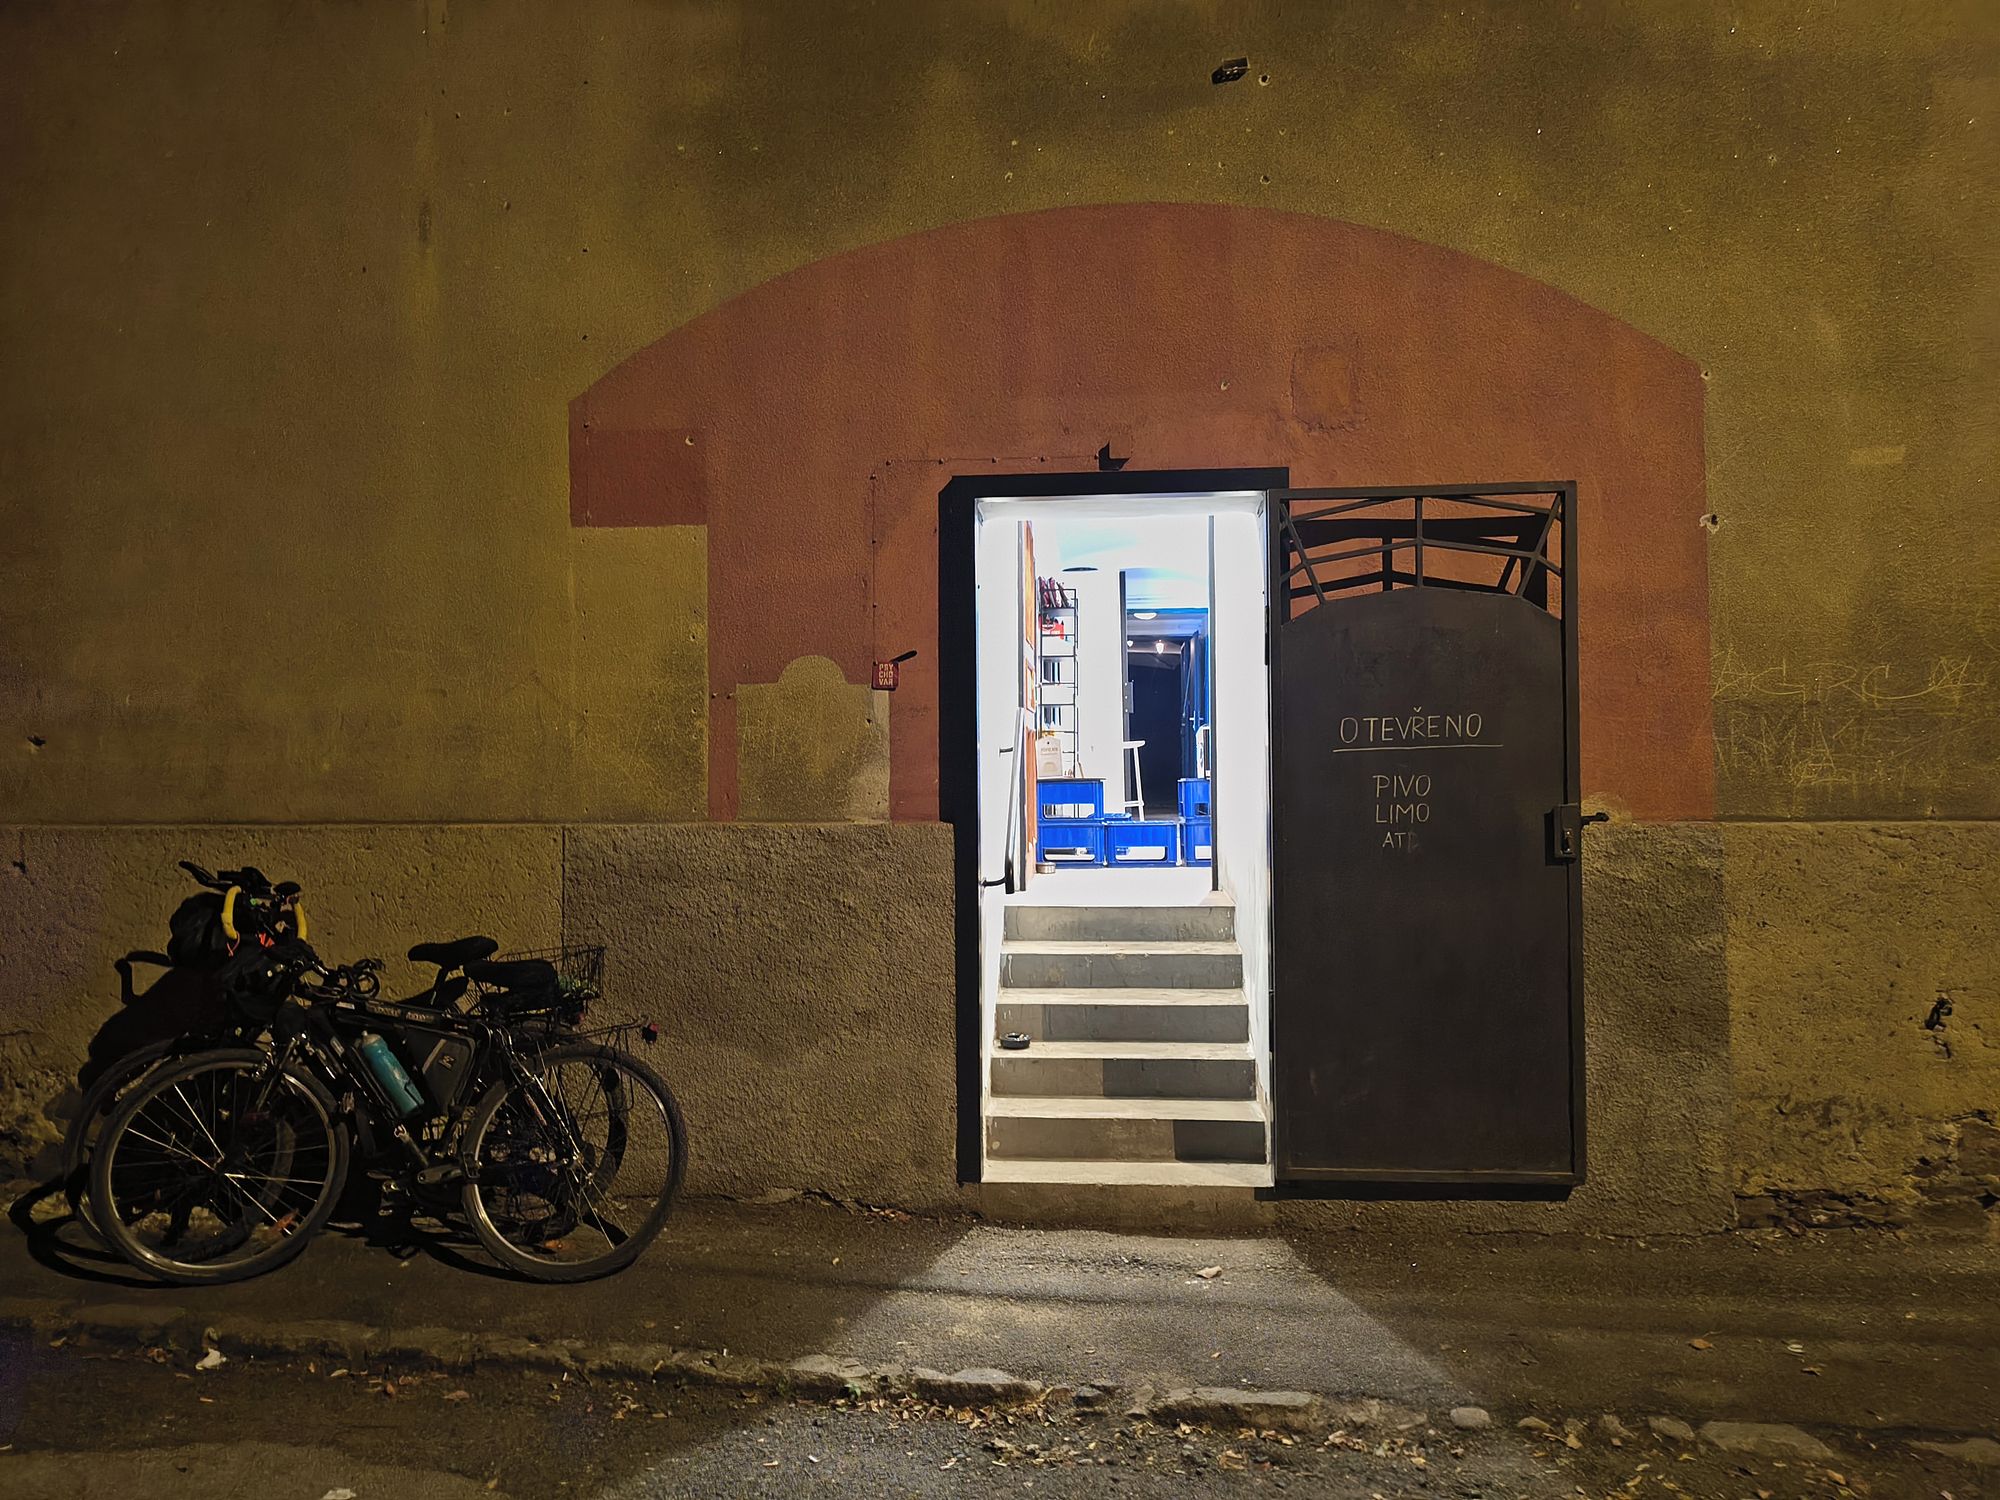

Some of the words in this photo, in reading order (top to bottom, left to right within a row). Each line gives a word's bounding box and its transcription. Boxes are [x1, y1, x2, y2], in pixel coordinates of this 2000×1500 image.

[878, 678, 894, 686] VAR
[1339, 706, 1482, 744] OTEVŘENO
[1373, 774, 1432, 798] PIVO
[1375, 803, 1430, 824] LIMO
